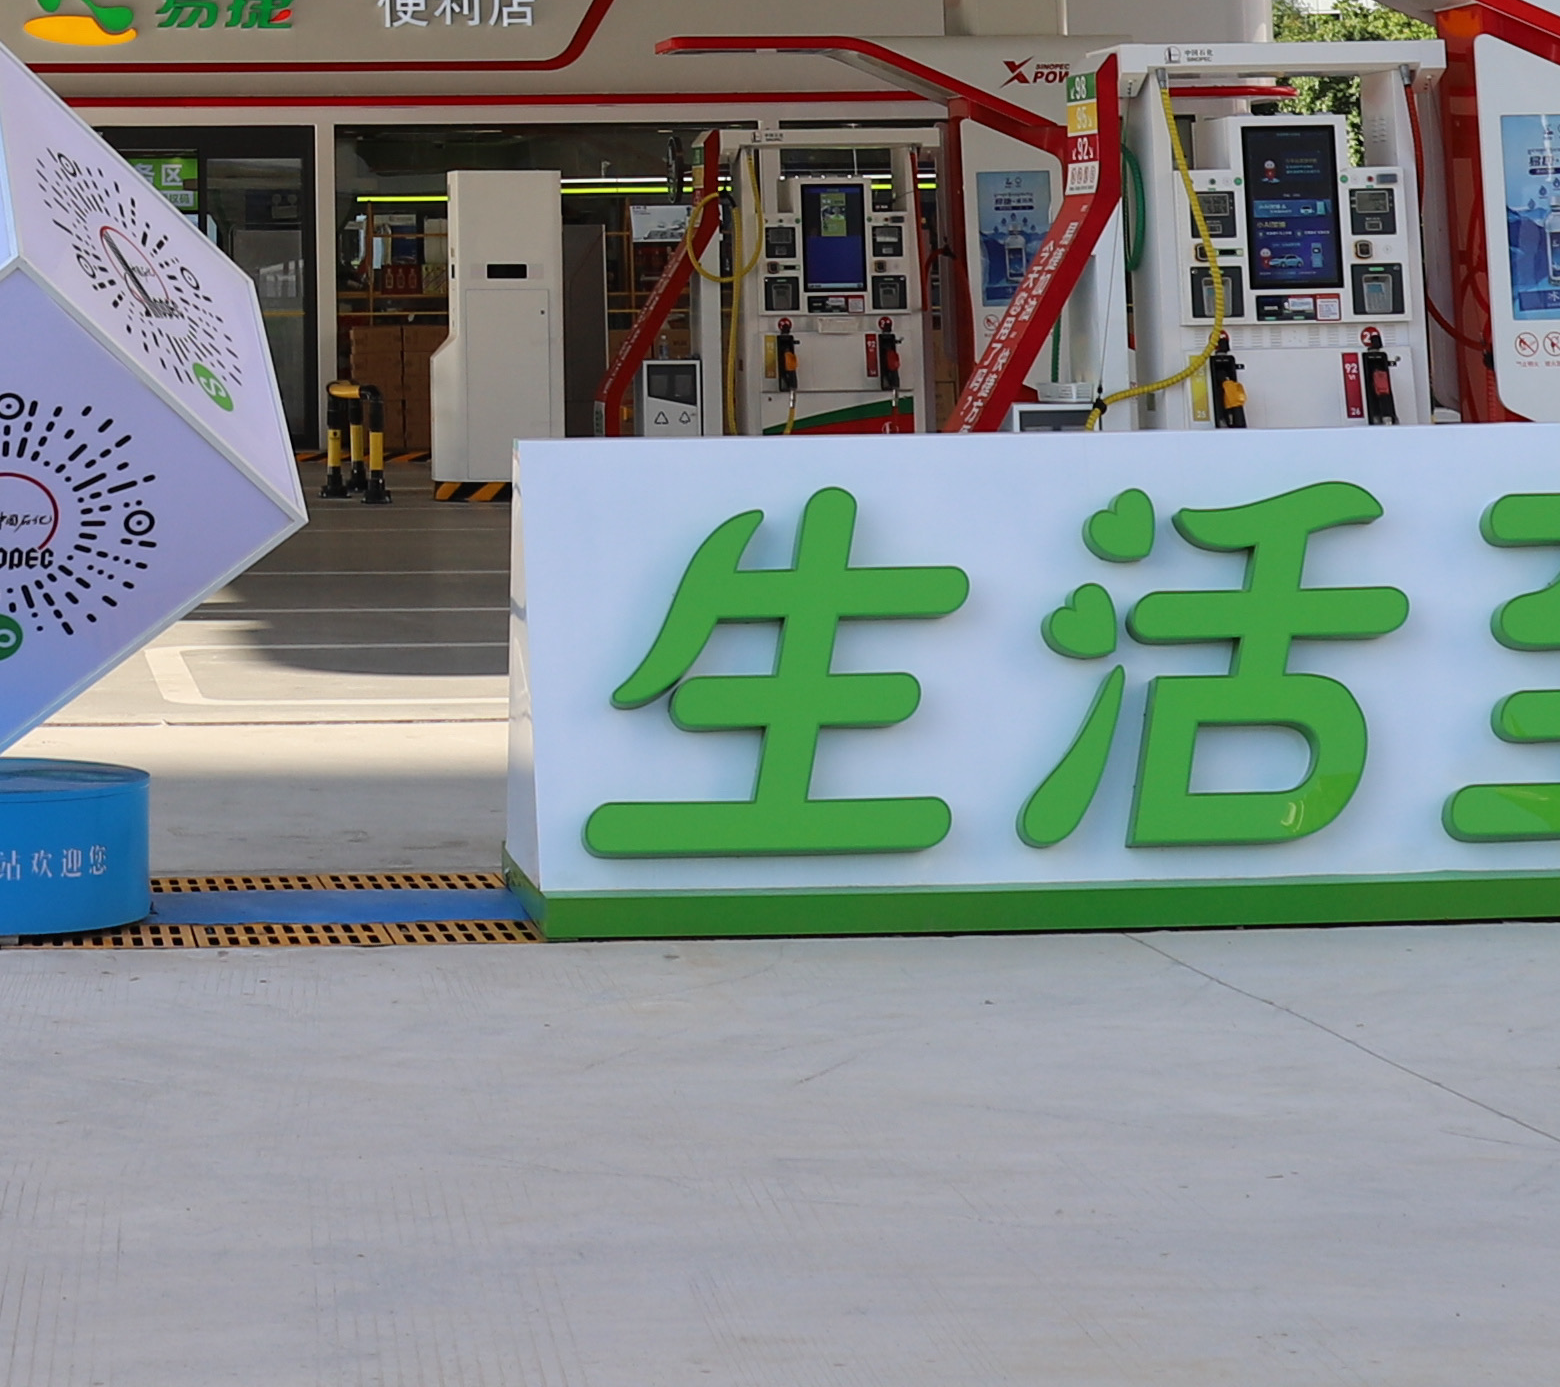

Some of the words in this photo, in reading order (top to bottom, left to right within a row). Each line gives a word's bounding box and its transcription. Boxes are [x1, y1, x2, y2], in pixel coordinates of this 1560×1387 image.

[1035, 63, 1070, 71] SINOPEC
[1074, 75, 1087, 100] 98
[1077, 137, 1089, 161] 92
[866, 340, 876, 348] 92
[1344, 363, 1358, 374] 92
